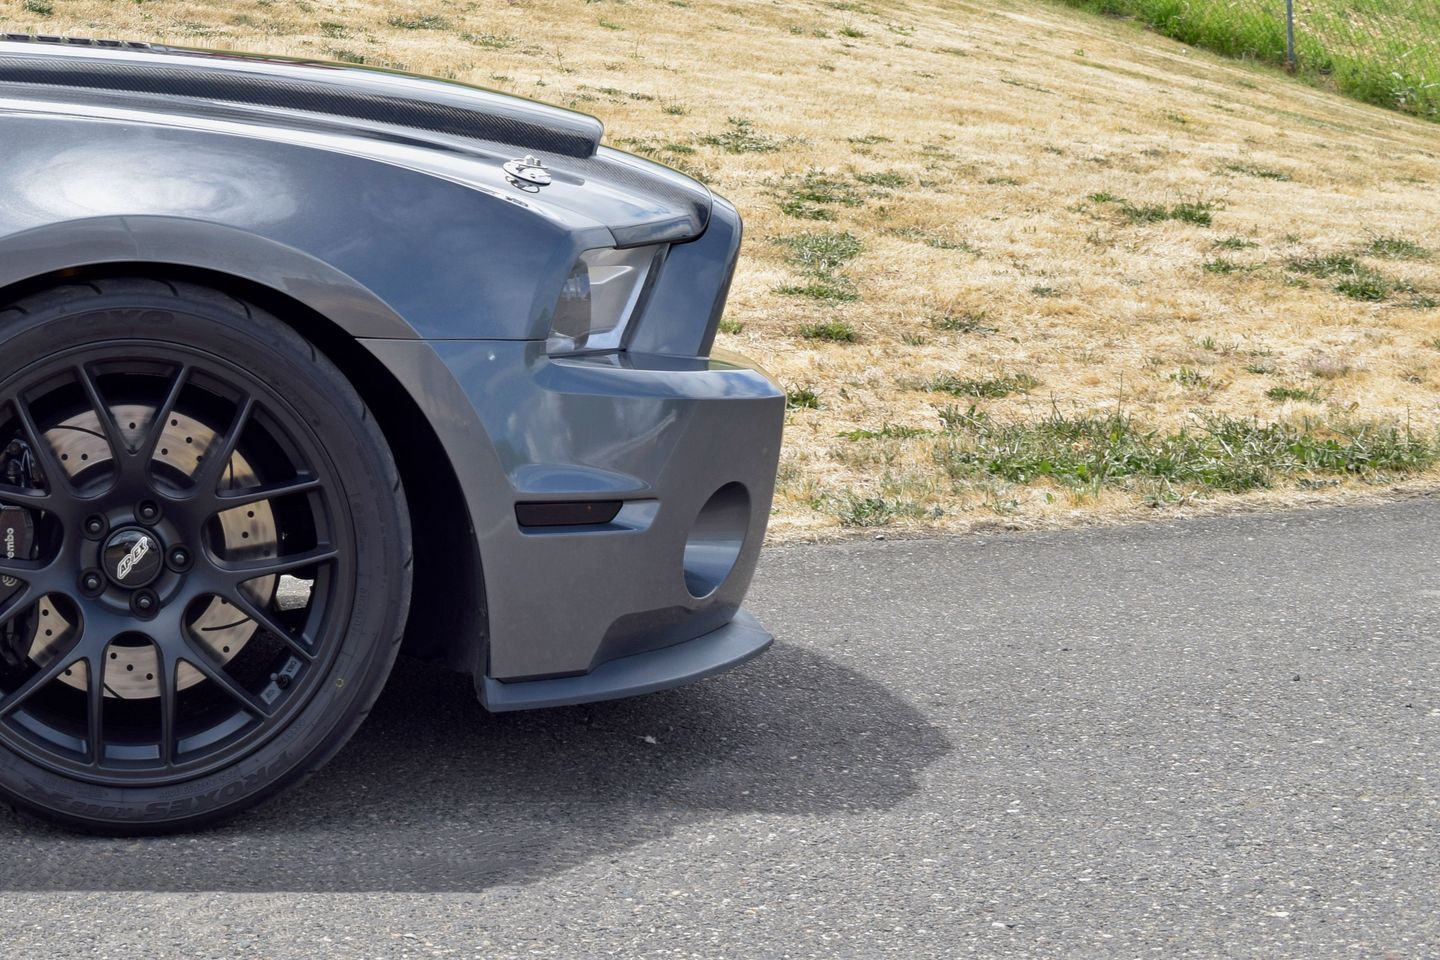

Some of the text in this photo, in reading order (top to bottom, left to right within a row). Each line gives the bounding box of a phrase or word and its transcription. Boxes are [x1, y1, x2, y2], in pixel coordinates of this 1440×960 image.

[4, 527, 15, 560] embo
[117, 537, 149, 580] APEX
[143, 749, 290, 816] PROXES
